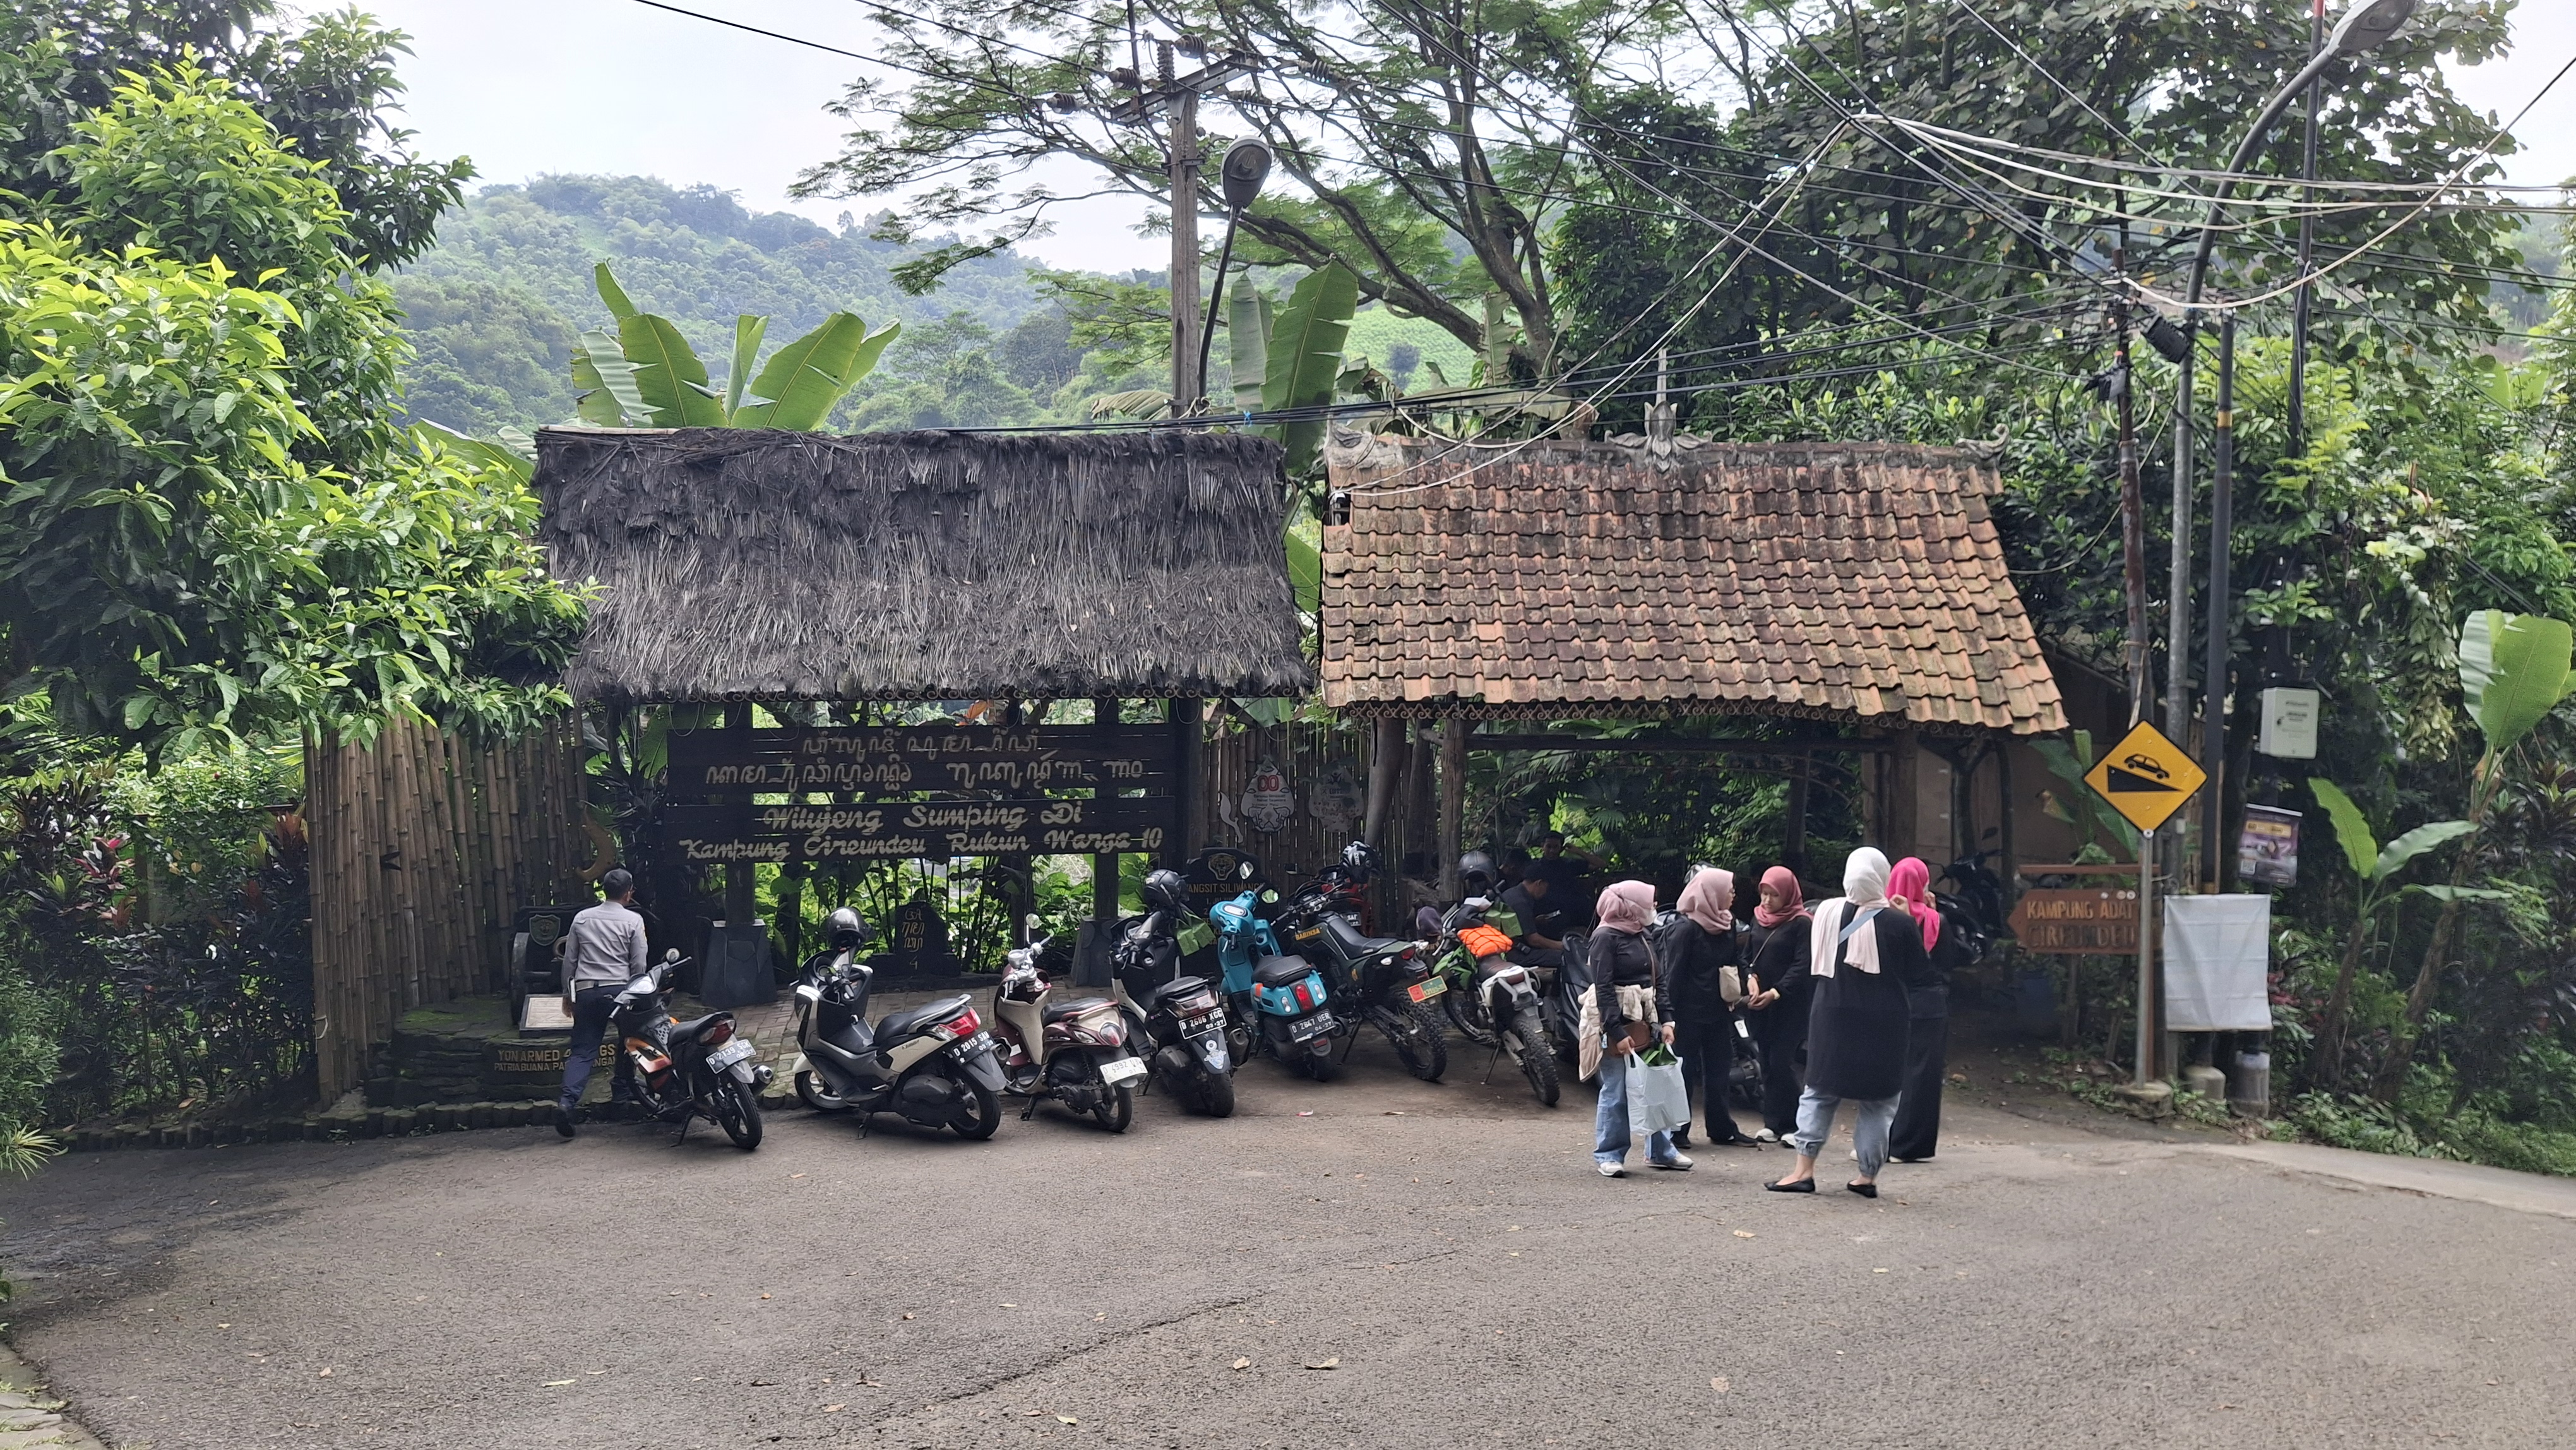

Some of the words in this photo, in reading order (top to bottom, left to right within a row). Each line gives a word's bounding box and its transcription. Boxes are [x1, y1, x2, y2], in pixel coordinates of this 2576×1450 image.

[764, 805, 884, 836] Wilujeng
[903, 802, 1029, 832] Sumping
[1041, 800, 1083, 825] Di
[679, 839, 790, 861] Kampung
[804, 834, 927, 856] Cireundeu
[946, 830, 1030, 853] Rukun
[1044, 829, 1131, 854] Warga
[1141, 827, 1163, 849] 10
[1186, 883, 1218, 893] ANGSIT
[2027, 900, 2094, 920] KAMPUNG
[2100, 901, 2134, 920] ADAT
[1181, 1022, 1187, 1030] D
[1291, 1025, 1297, 1033] D
[498, 1050, 518, 1062] YON
[520, 1050, 560, 1062] ARMED
[599, 1043, 616, 1057] GS
[716, 1046, 736, 1060] 2139
[953, 1048, 961, 1057] D
[960, 1037, 977, 1052] 2015
